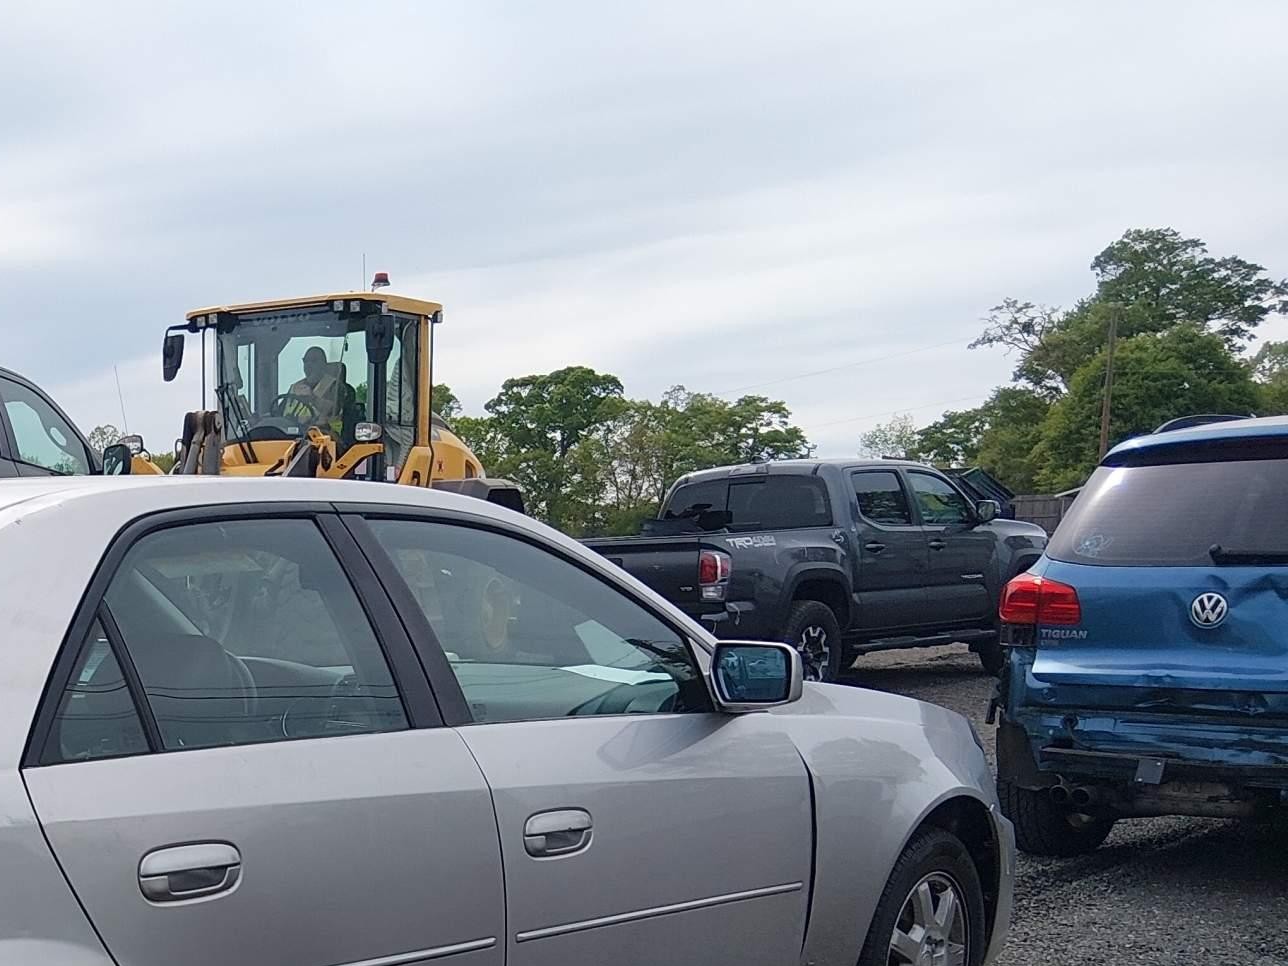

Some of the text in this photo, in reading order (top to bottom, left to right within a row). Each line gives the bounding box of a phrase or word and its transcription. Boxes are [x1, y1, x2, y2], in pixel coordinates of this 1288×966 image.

[725, 537, 753, 549] TRD
[1193, 593, 1226, 624] VW
[1040, 629, 1088, 639] TIGUAN
